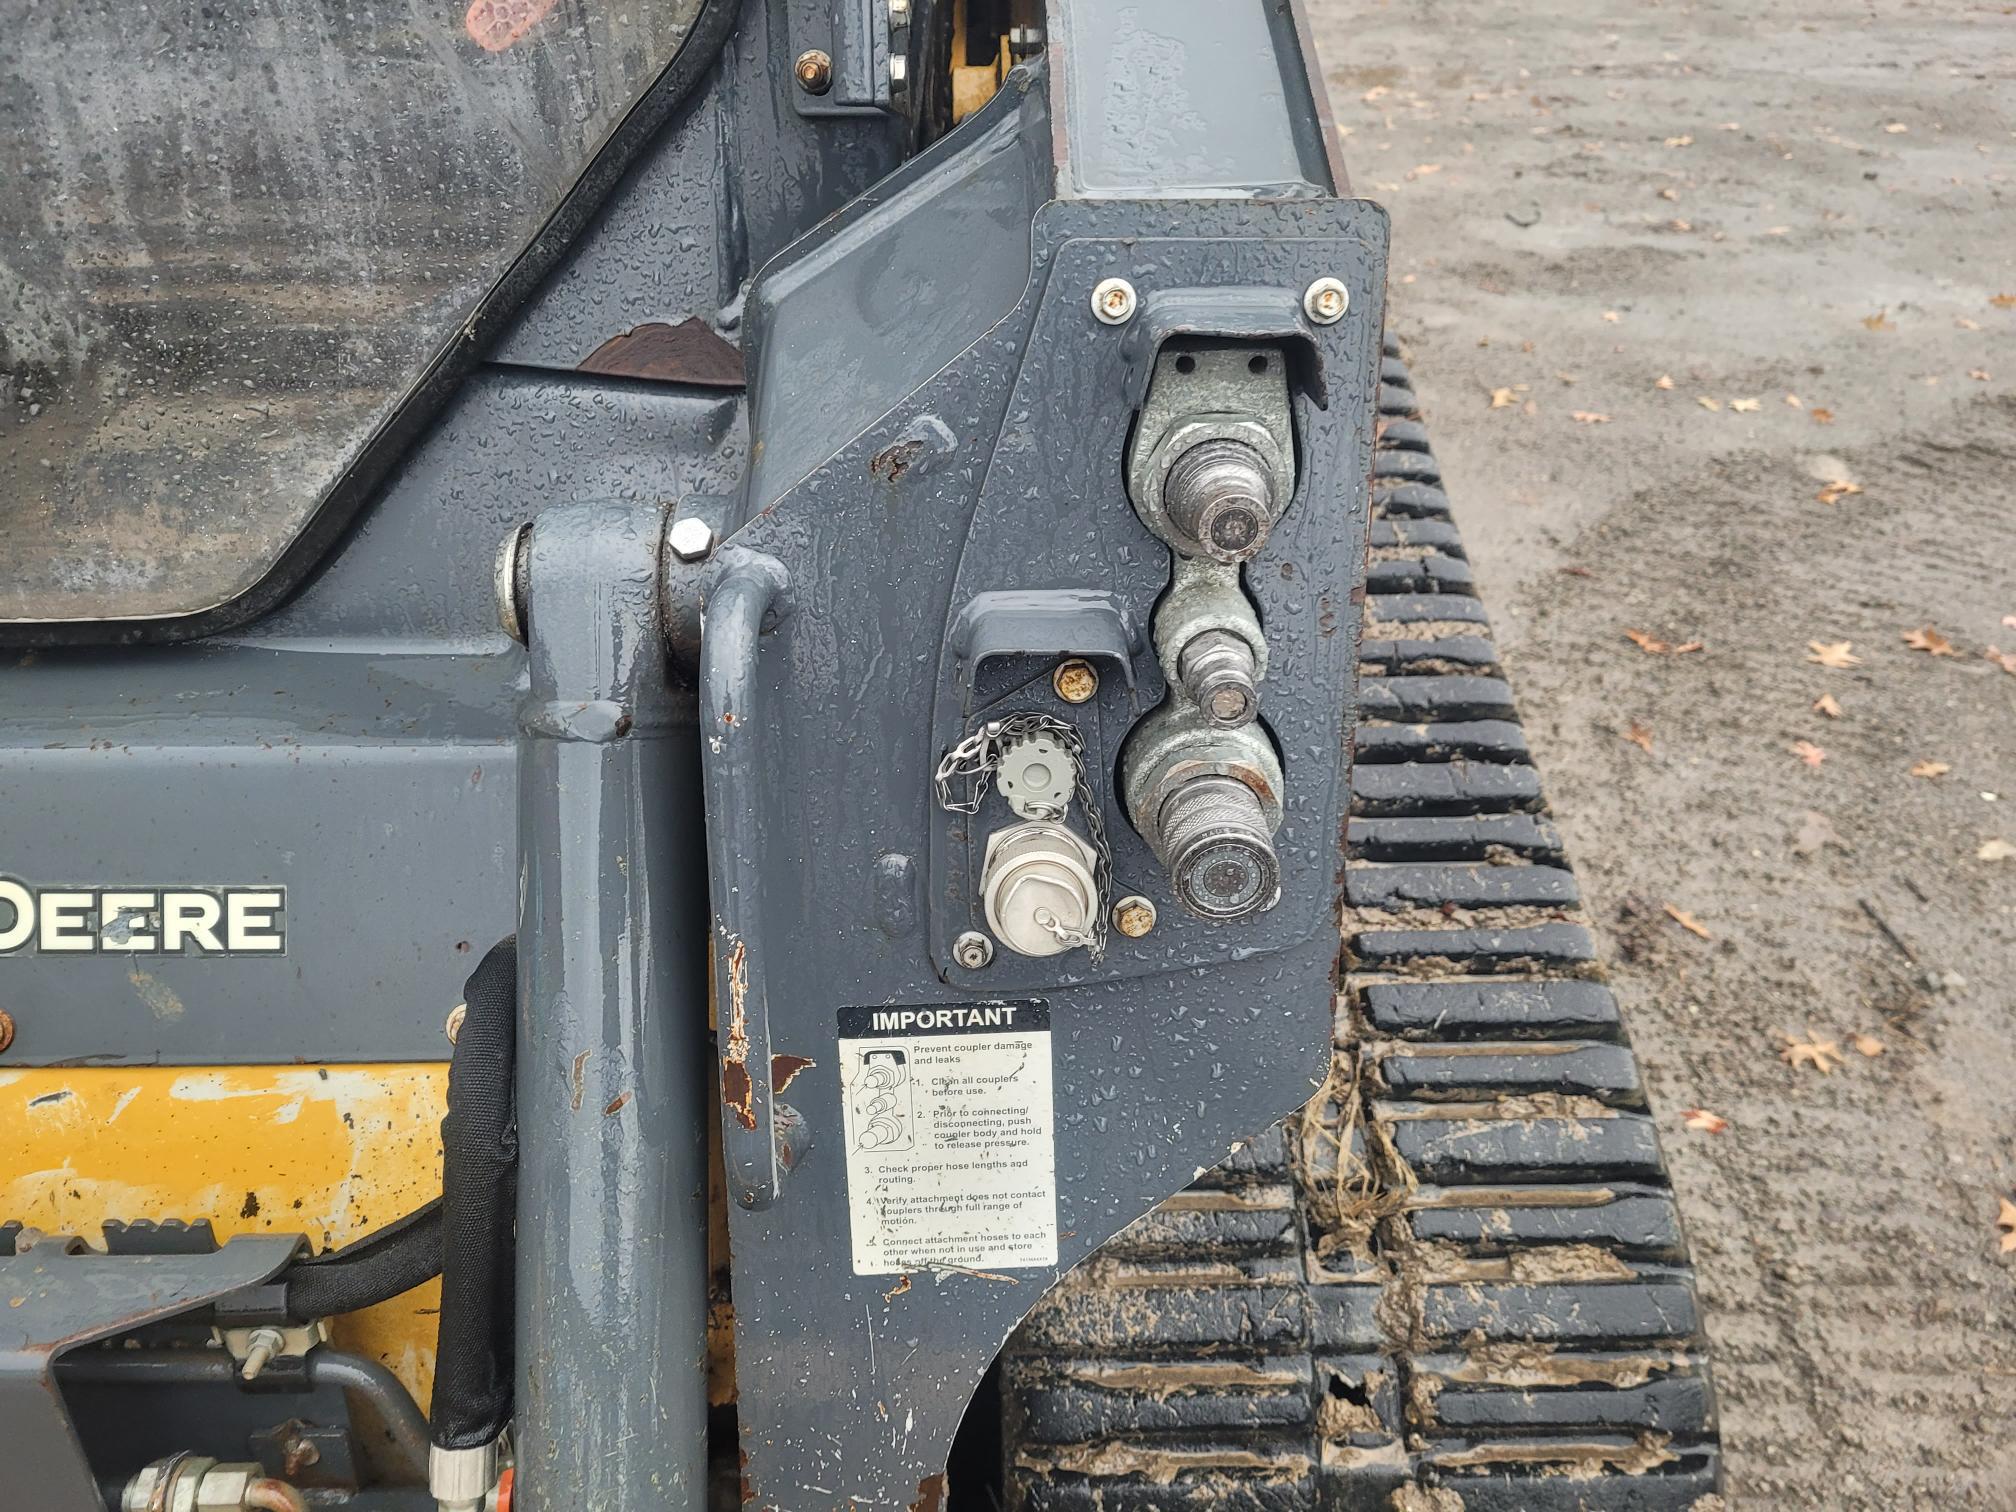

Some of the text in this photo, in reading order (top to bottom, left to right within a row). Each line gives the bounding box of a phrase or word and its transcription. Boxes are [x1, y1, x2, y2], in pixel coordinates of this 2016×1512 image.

[872, 1007, 1017, 1031] IMPORTANT
[913, 1041, 1033, 1054] Prevent coupler damage
[914, 1055, 960, 1064] and leaks
[916, 1079, 924, 1087] 1.
[962, 1076, 974, 1085] all
[976, 1075, 1019, 1085] couplers
[932, 1087, 986, 1096] before use.
[917, 1106, 1029, 1119] 2. Prior to connecting/
[933, 1117, 1032, 1129] disconnecting, push
[934, 1126, 1042, 1140] coupler body and hold
[934, 1140, 1030, 1150] to release pressure.
[864, 1159, 1028, 1174] 3. Check proper hose lengths and
[878, 1175, 916, 1185] routing.
[880, 1196, 908, 1206] Verify
[910, 1194, 963, 1204] attachment
[966, 1193, 990, 1202] does
[992, 1192, 1008, 1200] not
[1010, 1190, 1046, 1199] contact
[881, 1206, 922, 1216] ouplers
[965, 1203, 981, 1212] full
[983, 1203, 1010, 1212] range
[1013, 1201, 1023, 1209] of
[881, 1217, 917, 1226] motion.
[882, 1238, 922, 1246] Connect
[925, 1234, 978, 1245] attachment
[981, 1233, 1009, 1242] hoses
[1024, 1231, 1047, 1240] each
[883, 1243, 1033, 1256] other when not in use and store
[947, 1253, 984, 1265] ground.
